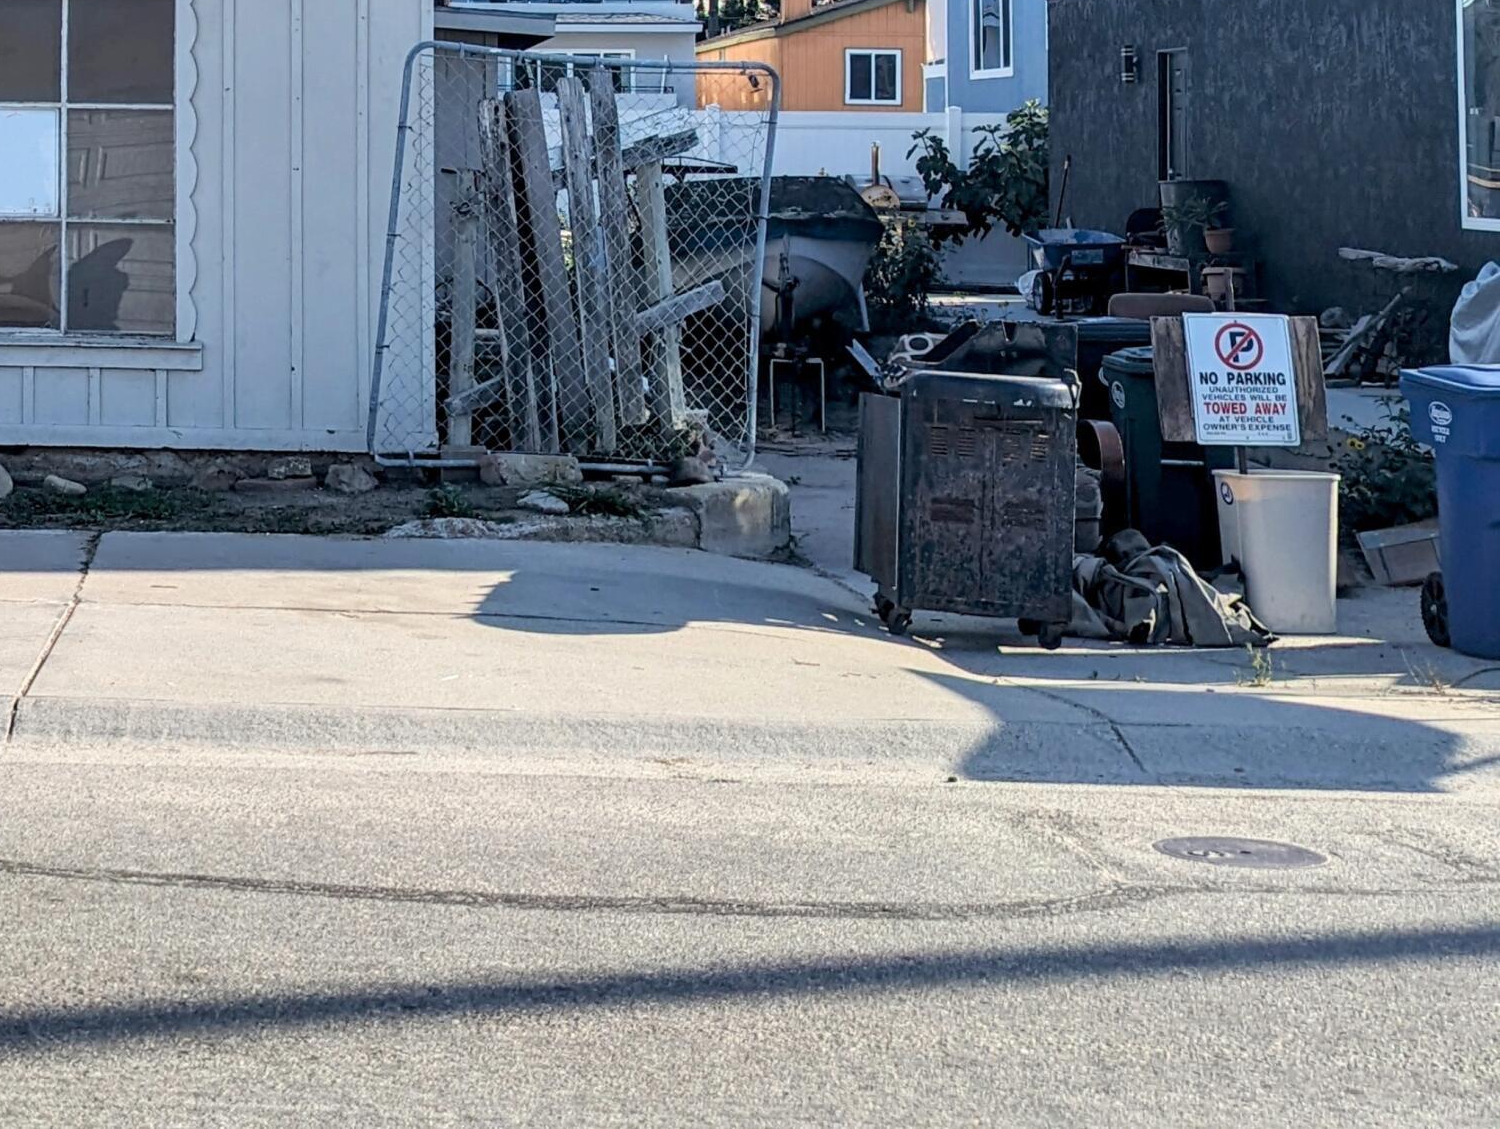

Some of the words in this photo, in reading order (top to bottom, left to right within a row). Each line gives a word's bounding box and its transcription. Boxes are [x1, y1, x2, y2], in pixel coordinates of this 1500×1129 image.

[1199, 372, 1218, 385] NO
[1227, 372, 1286, 385] PARKING
[1275, 394, 1288, 402] BE
[1204, 402, 1247, 414] TOWED
[1255, 402, 1287, 415] AWAY
[1203, 423, 1246, 431] OWNER'S
